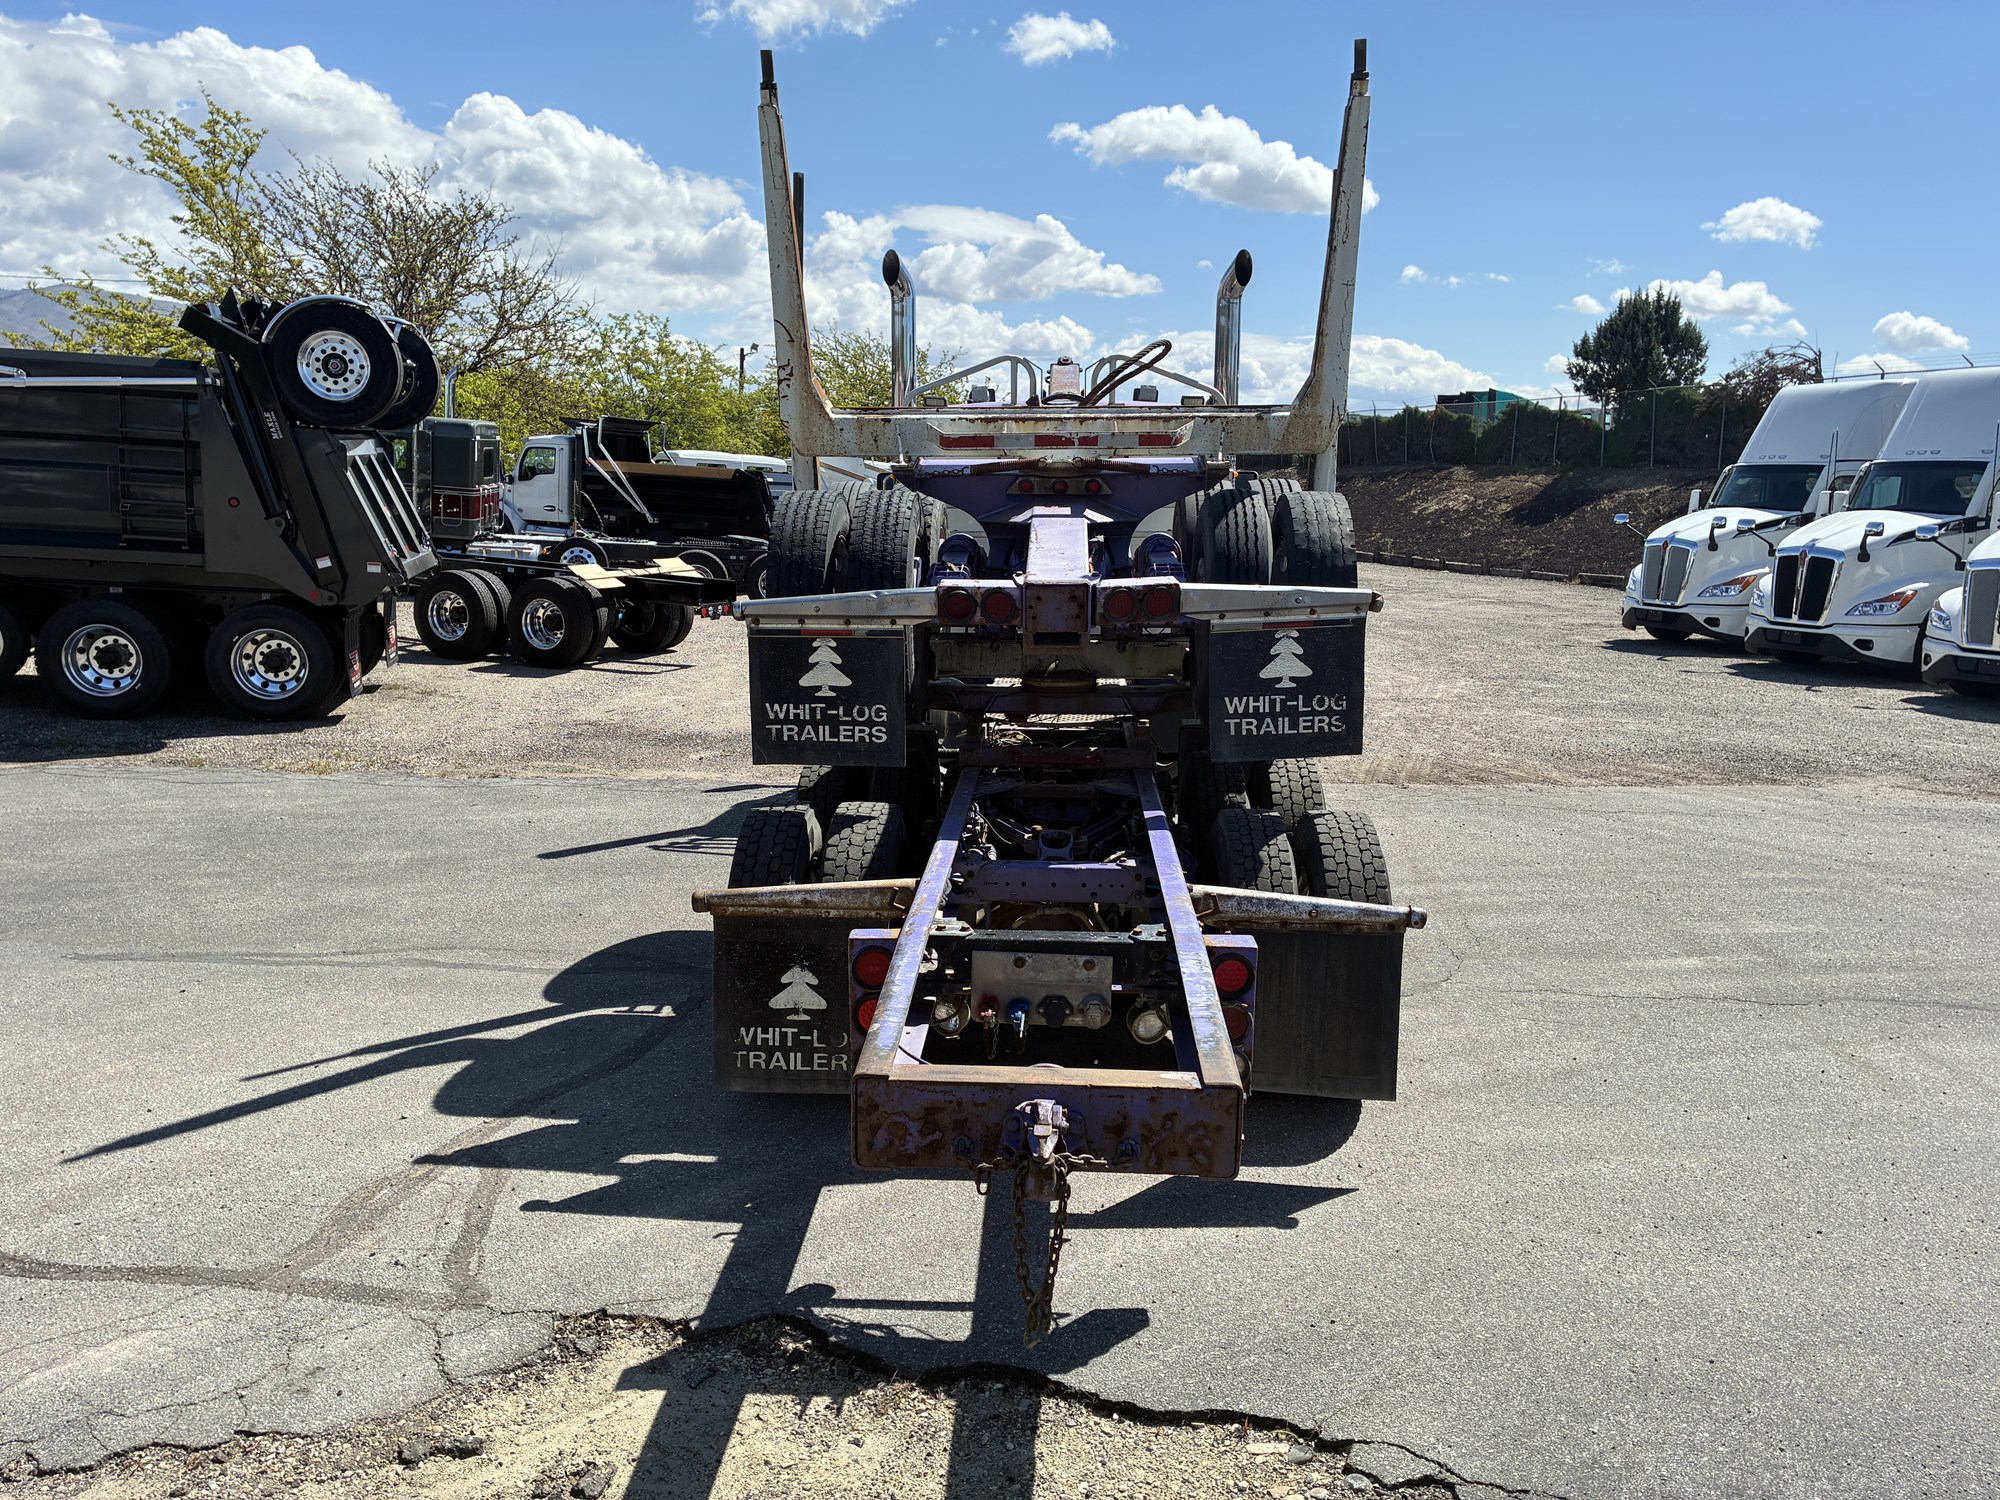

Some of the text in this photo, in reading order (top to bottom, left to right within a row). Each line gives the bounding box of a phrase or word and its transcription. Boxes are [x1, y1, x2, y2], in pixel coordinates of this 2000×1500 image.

[765, 703, 887, 722] WHIT-LOG
[1224, 694, 1346, 714] WHIT-LOG
[765, 725, 887, 743] TRAILERS
[1224, 716, 1345, 735] TRAILERS
